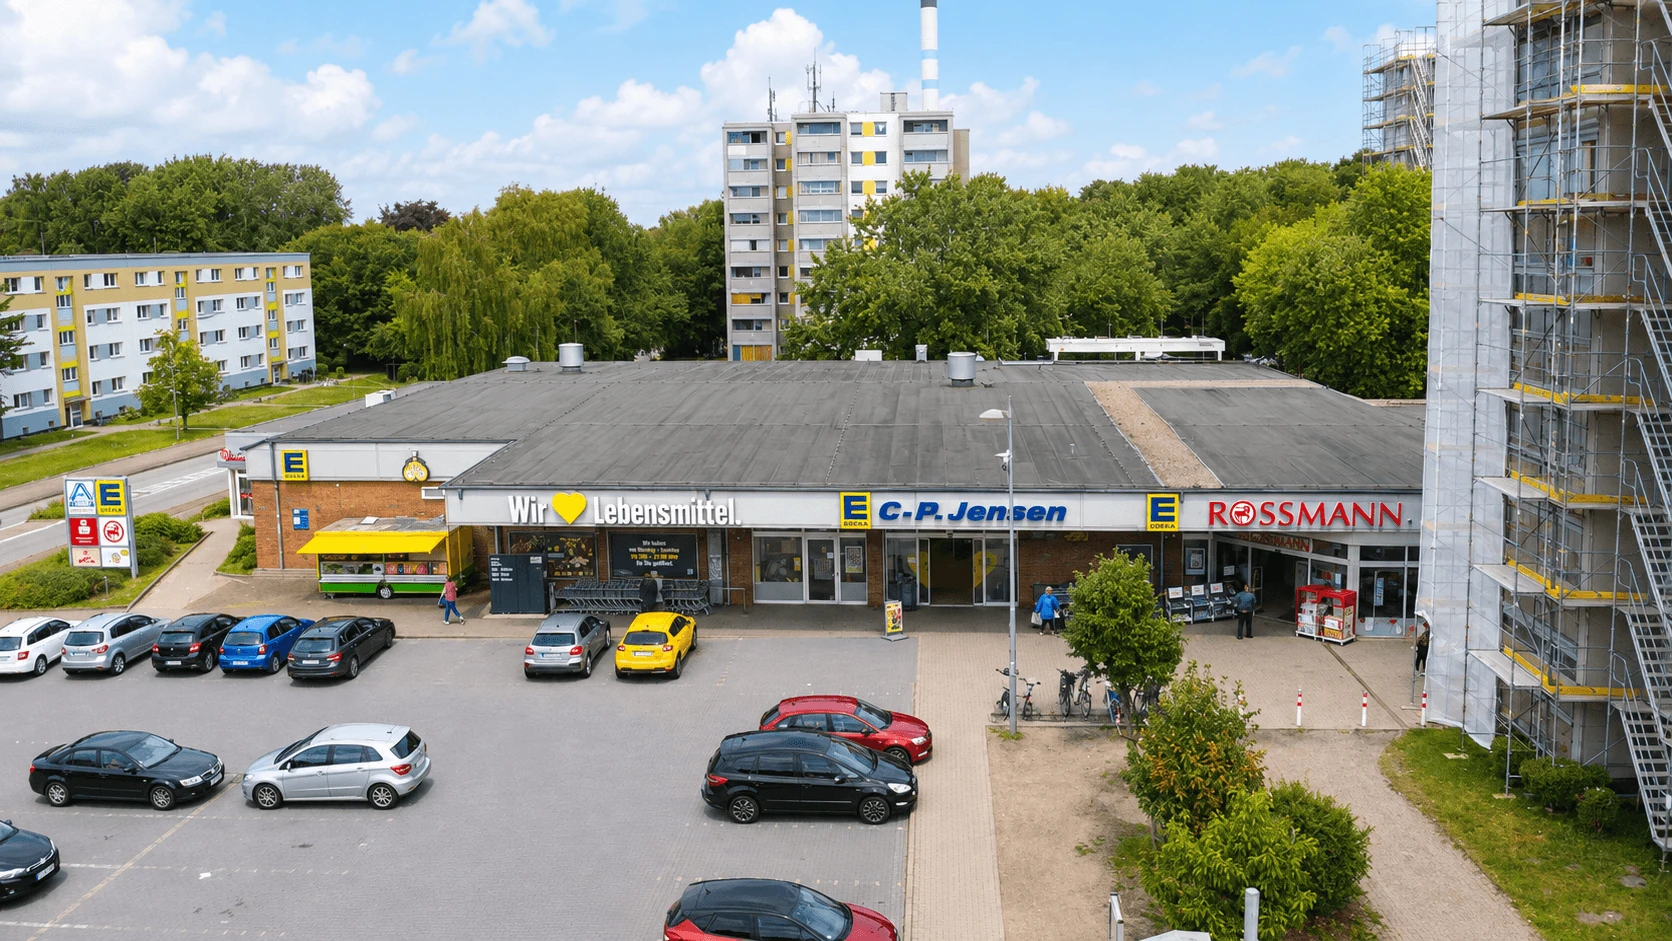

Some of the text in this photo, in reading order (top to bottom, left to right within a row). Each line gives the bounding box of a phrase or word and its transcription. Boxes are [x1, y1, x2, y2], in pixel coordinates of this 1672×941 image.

[283, 452, 304, 473] E
[99, 483, 121, 506] E
[507, 495, 742, 526] Wir Lebensmittel.
[843, 495, 868, 520] E
[947, 501, 1067, 522] Jensen
[1150, 497, 1175, 522] E
[1208, 500, 1402, 527] ROSSMANN
